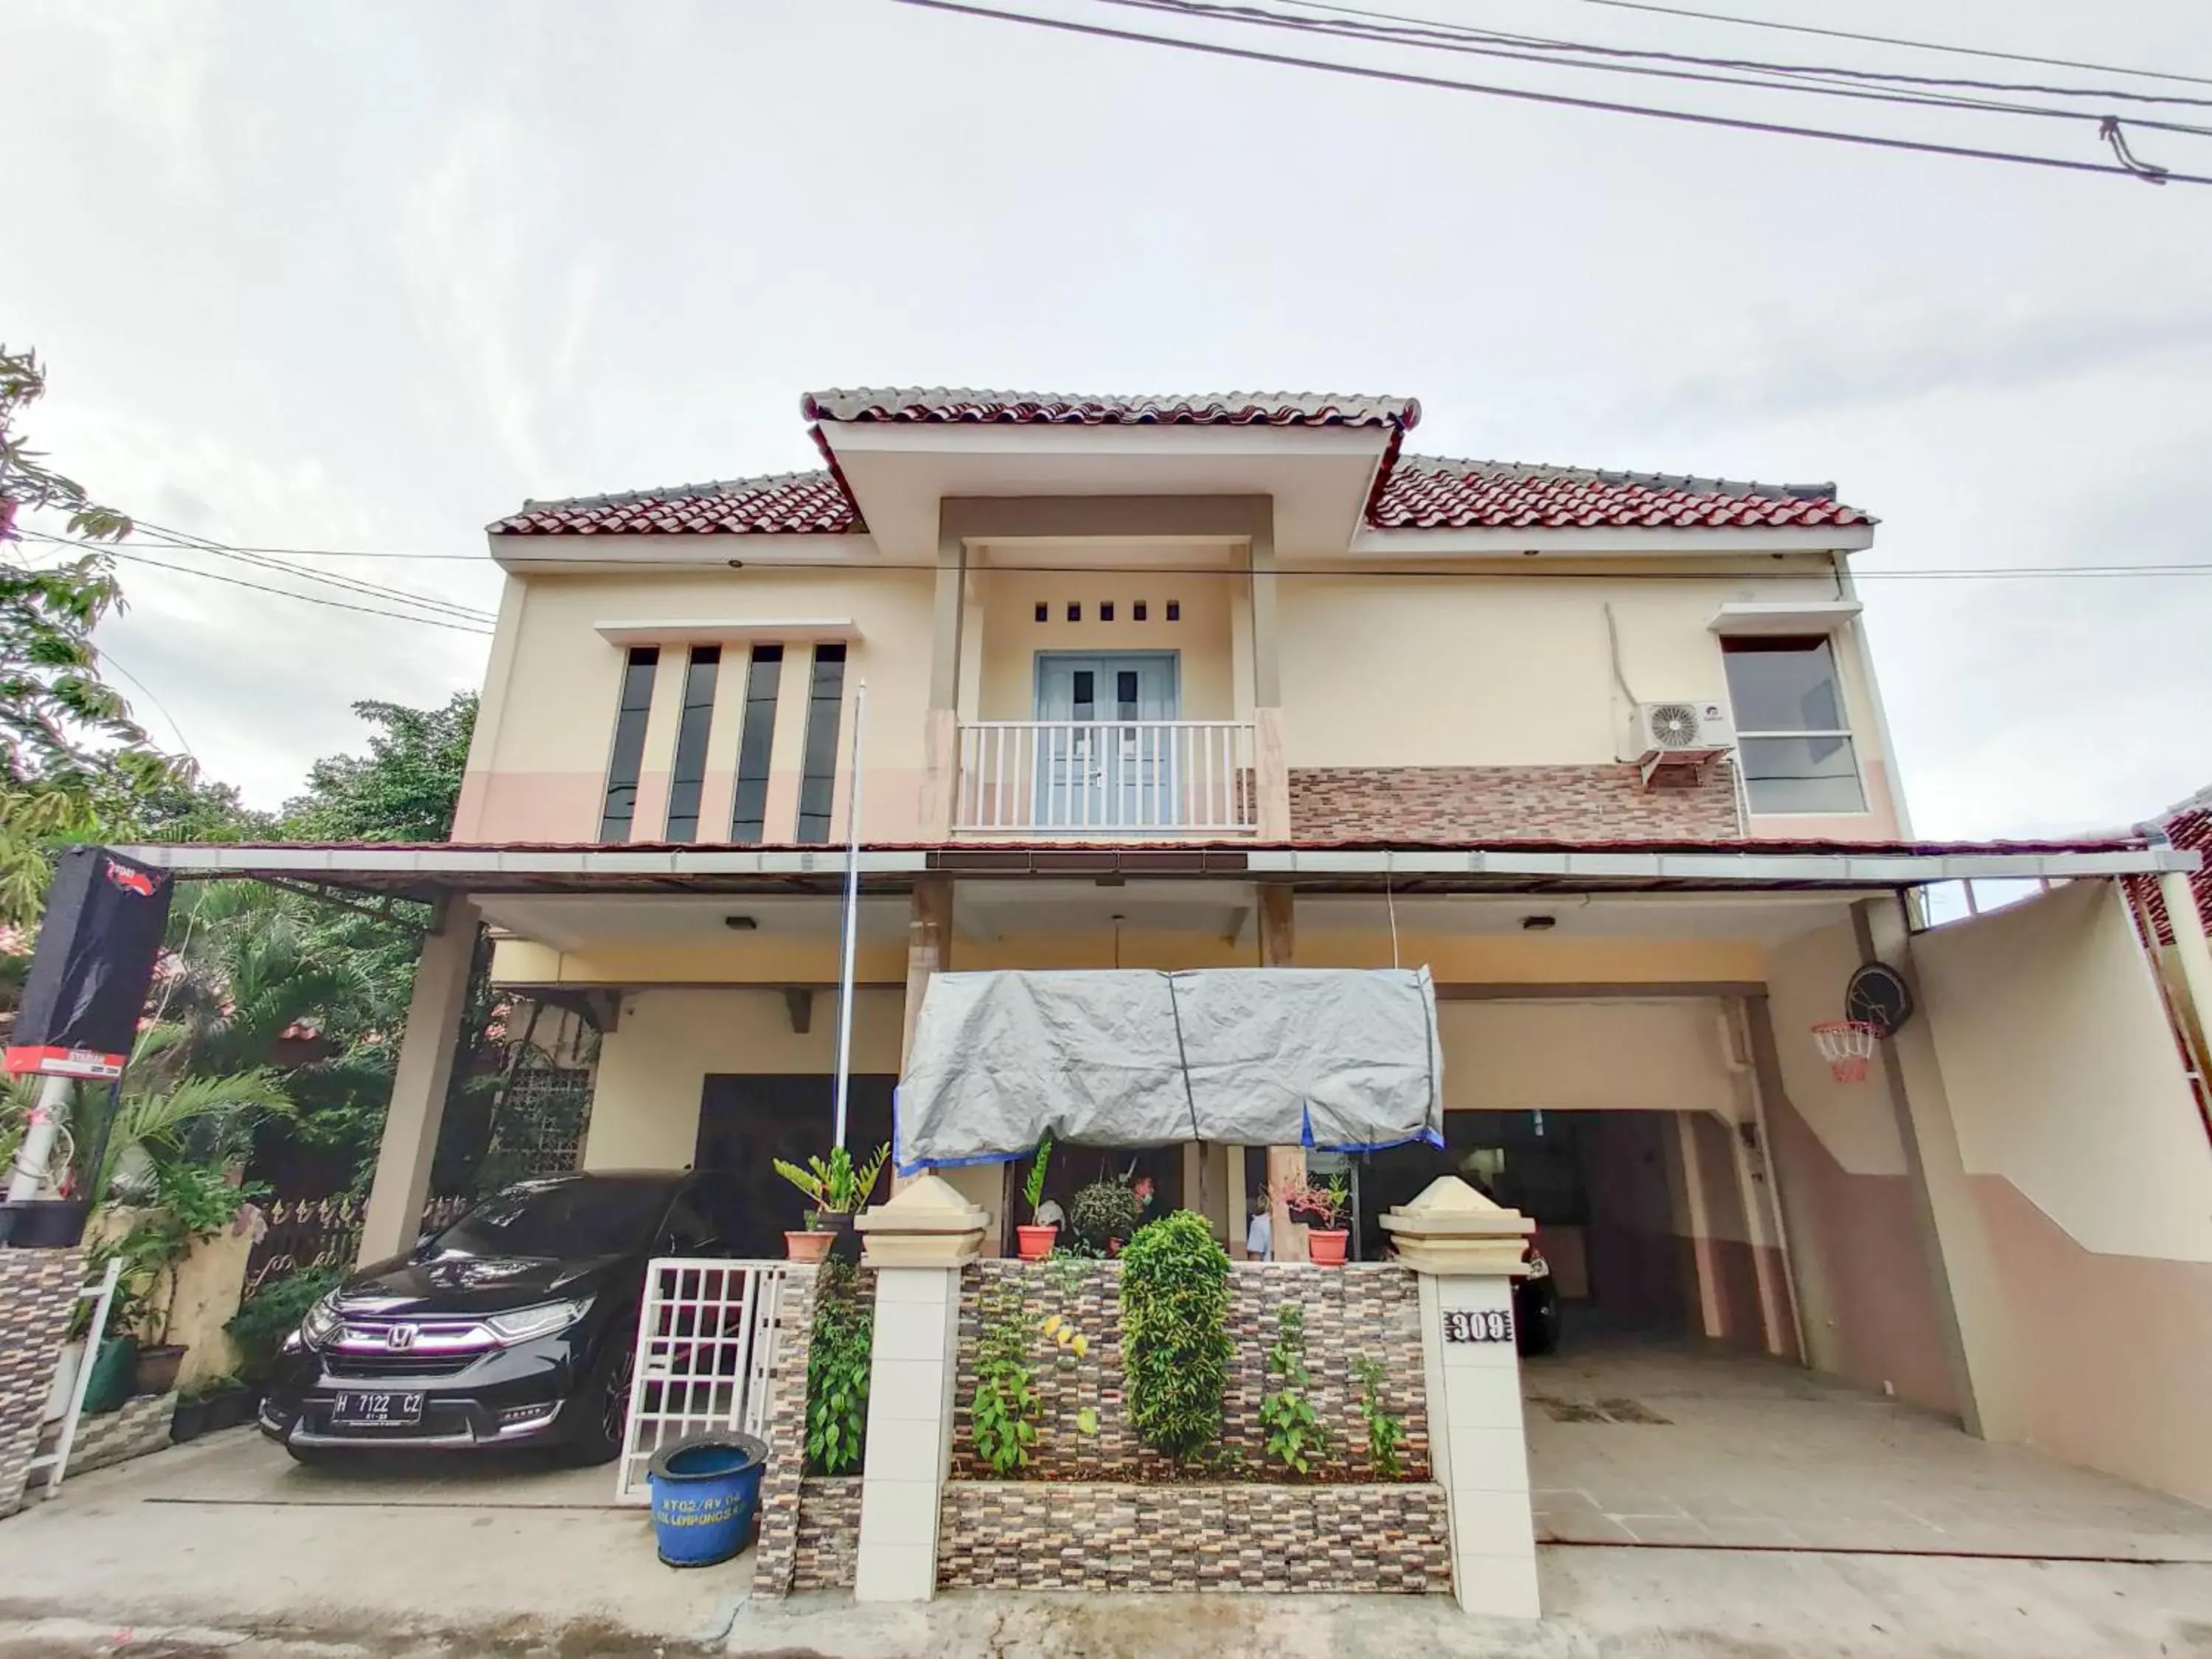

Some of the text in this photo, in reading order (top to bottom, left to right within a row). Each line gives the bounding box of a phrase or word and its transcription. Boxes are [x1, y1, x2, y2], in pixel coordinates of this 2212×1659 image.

[1452, 1313, 1504, 1340] 309
[337, 1394, 421, 1412] H 7122 CZ
